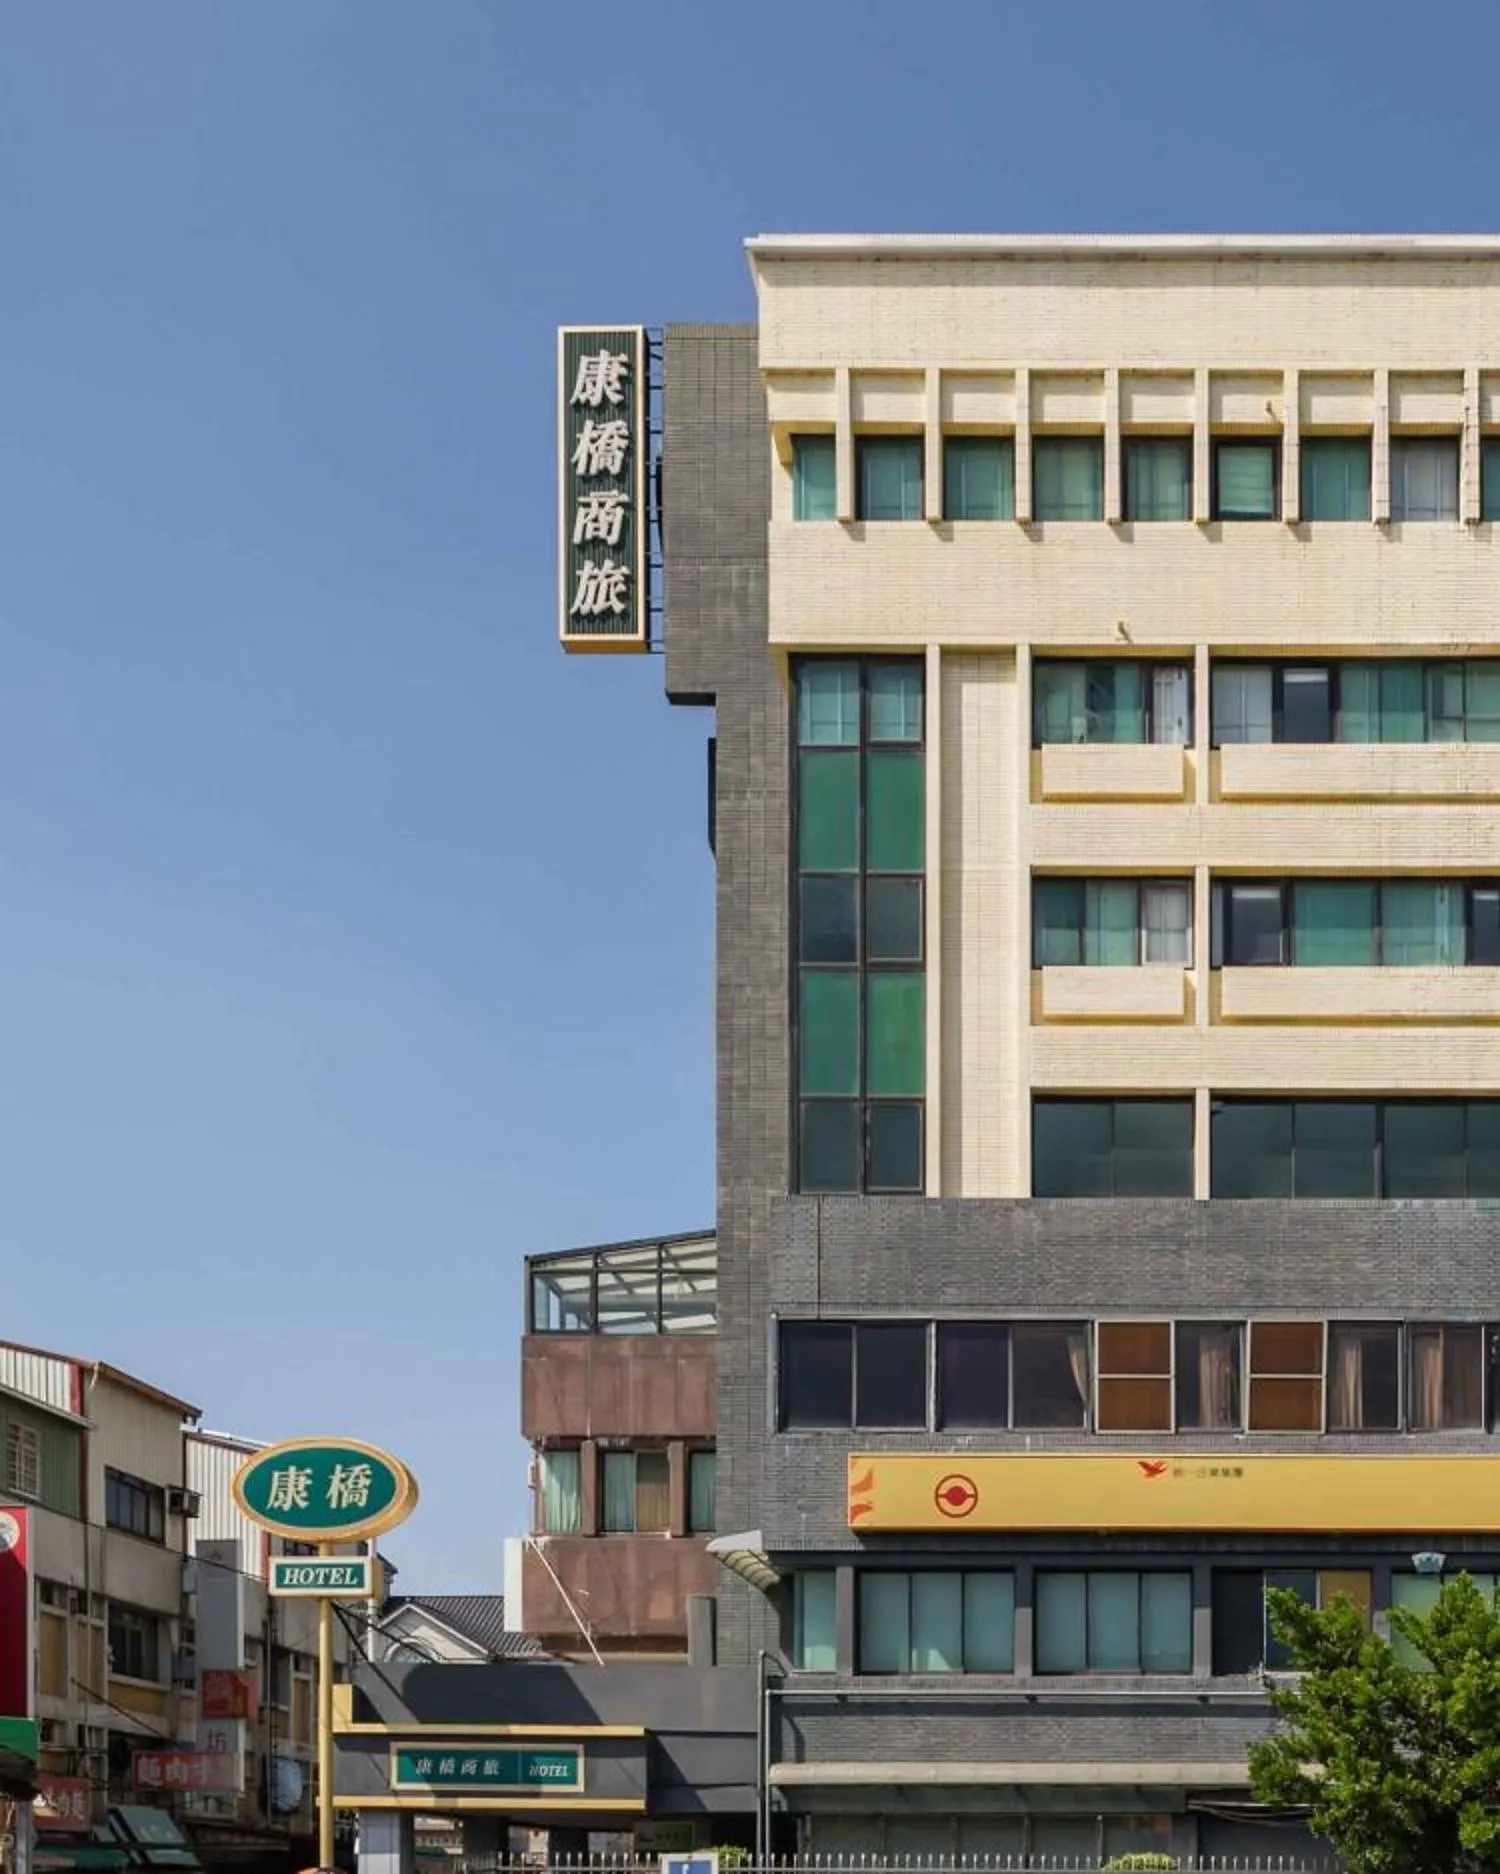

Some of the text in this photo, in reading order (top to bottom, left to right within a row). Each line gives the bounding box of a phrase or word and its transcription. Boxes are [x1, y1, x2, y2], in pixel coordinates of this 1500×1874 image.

[570, 349, 632, 617] 康橋商旅
[266, 1463, 373, 1511] 康橋
[283, 1567, 358, 1585] HOTEL
[415, 1757, 568, 1777] 康橋商旅 HOTEL
